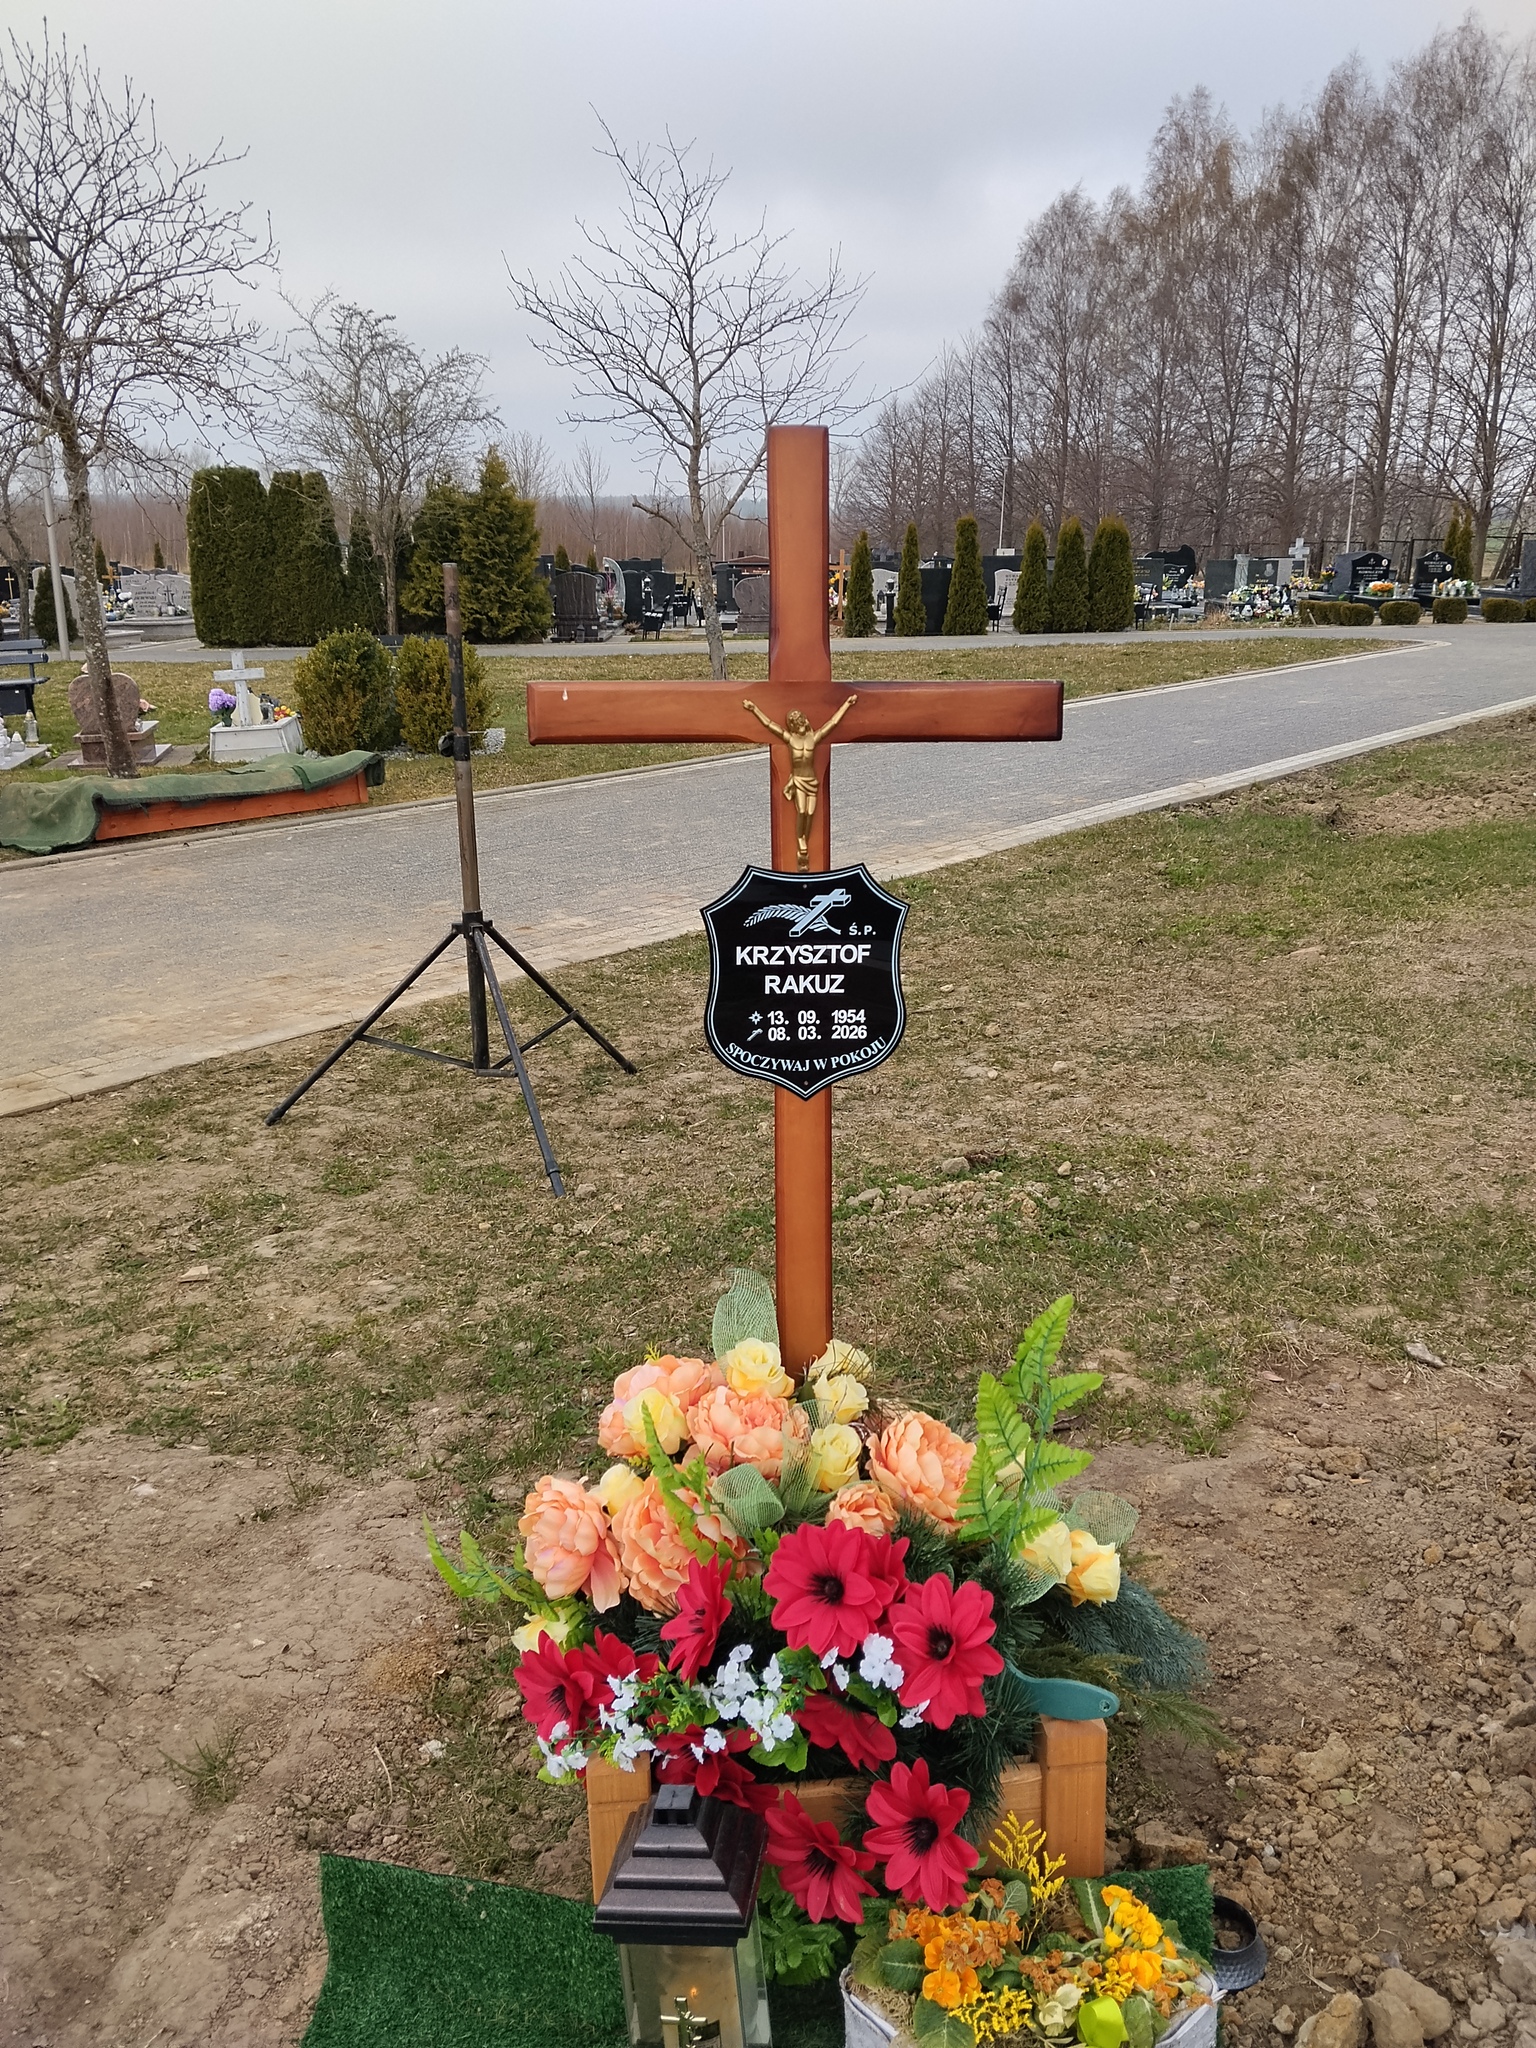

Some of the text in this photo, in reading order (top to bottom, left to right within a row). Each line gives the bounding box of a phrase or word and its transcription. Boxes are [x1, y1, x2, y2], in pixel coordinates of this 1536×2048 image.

[736, 944, 871, 965] KRZYSZTOF
[765, 975, 844, 994] RAKUZ
[768, 1009, 866, 1025] 13. 09. 1954
[768, 1025, 867, 1041] 08. 03. 2026
[725, 1037, 887, 1072] SPOCZYWAJ W POKOJU
